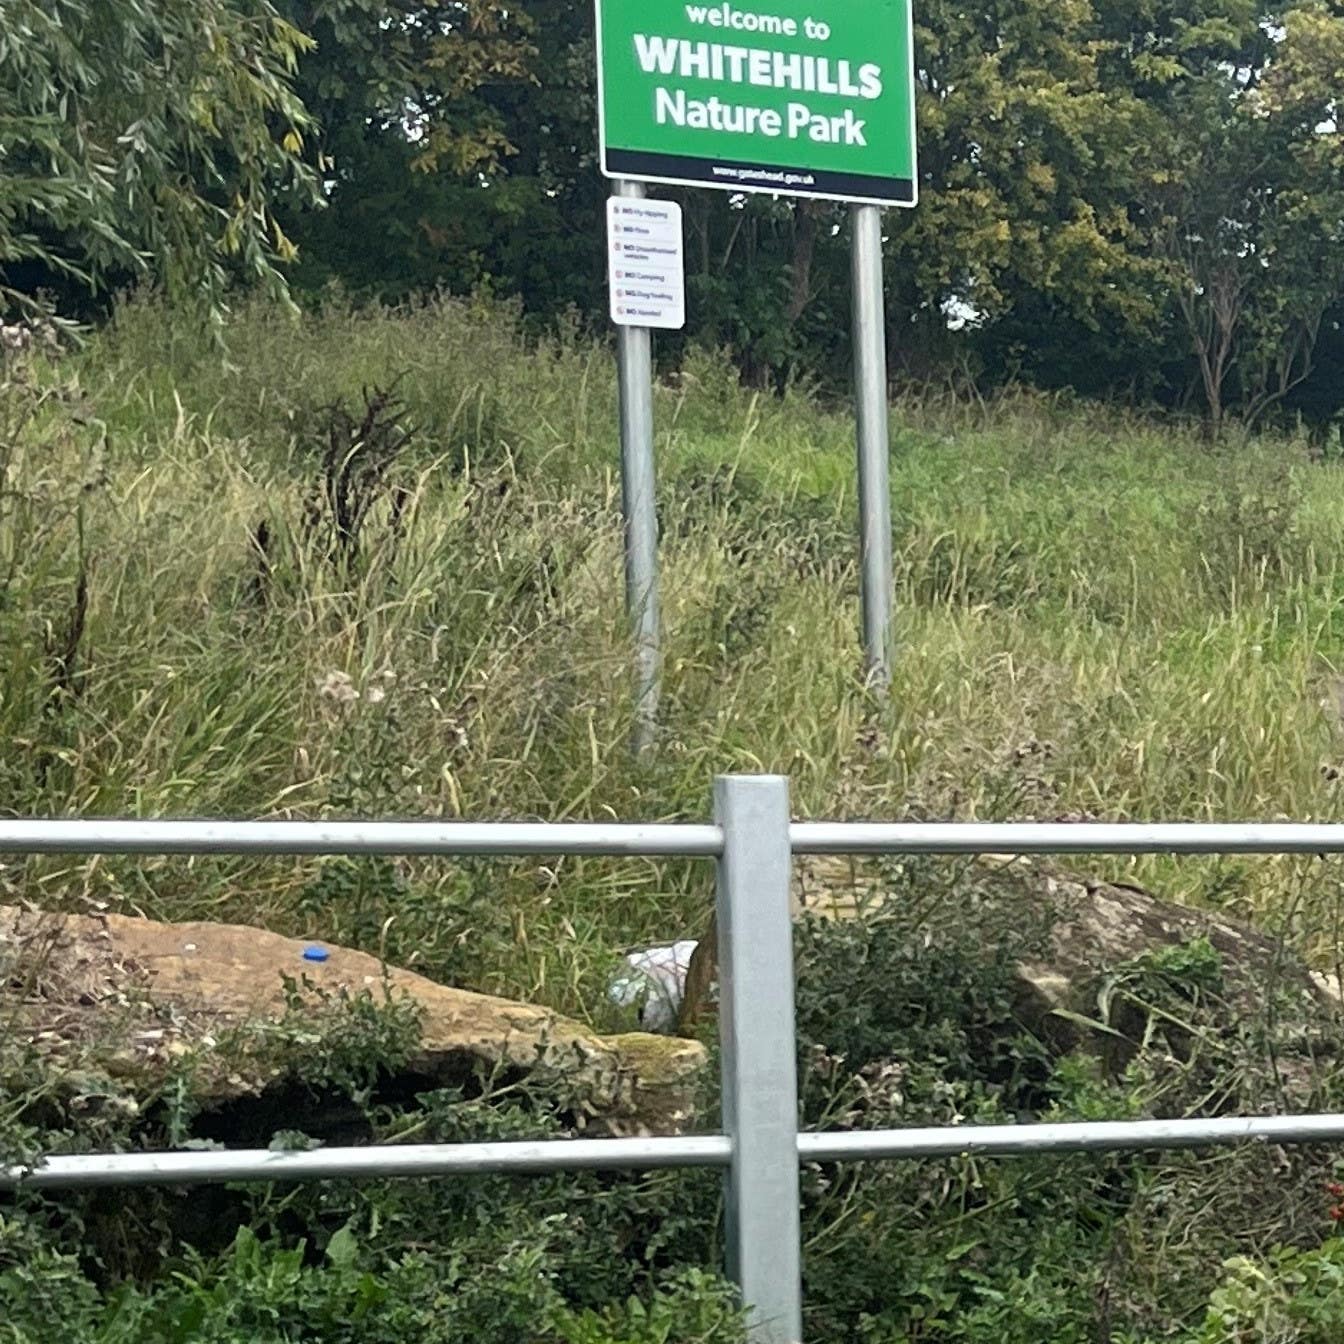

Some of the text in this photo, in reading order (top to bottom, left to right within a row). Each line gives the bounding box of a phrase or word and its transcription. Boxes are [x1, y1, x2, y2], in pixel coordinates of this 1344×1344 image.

[686, 2, 831, 41] welcome to
[633, 34, 883, 100] WHITEHILLS
[655, 87, 867, 147] Nature Park
